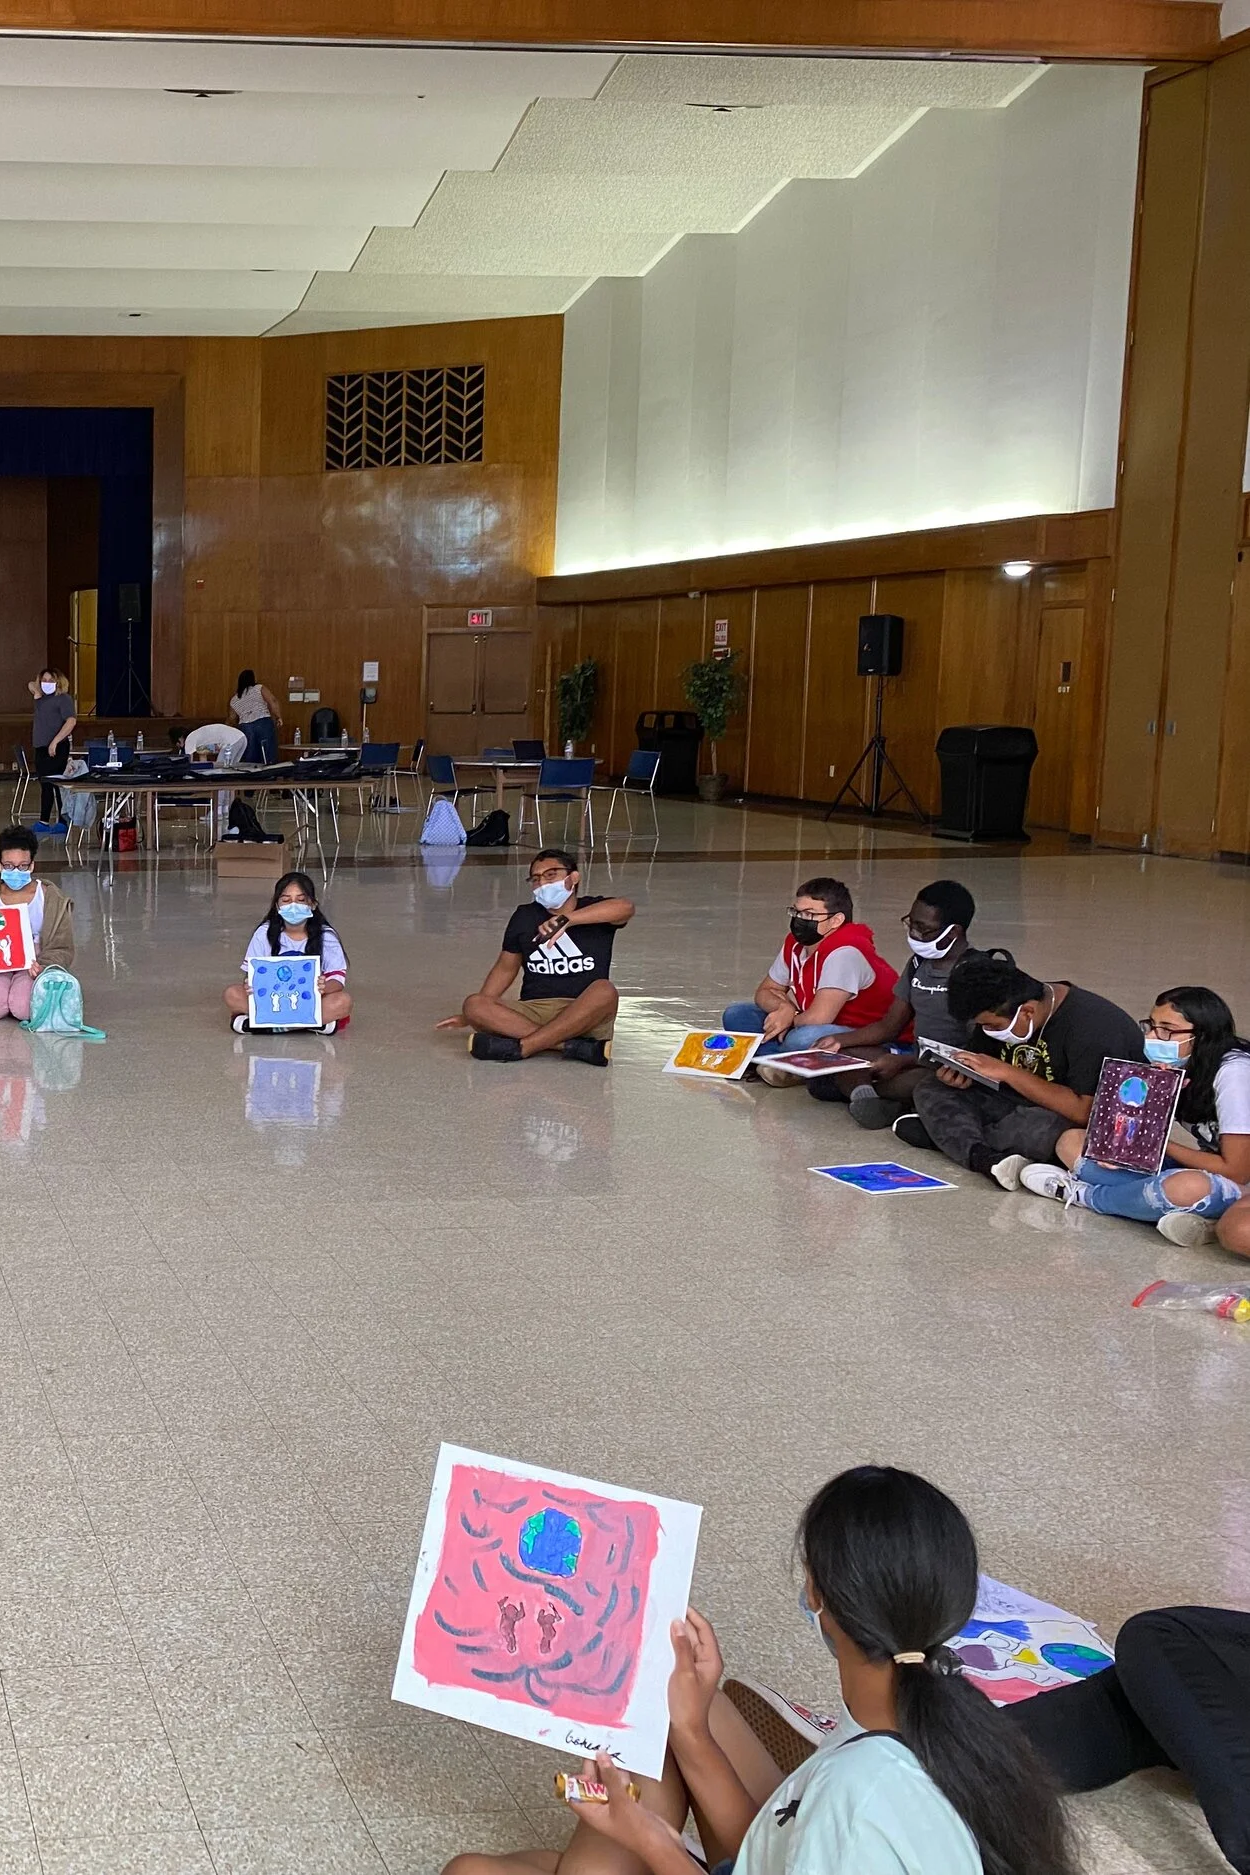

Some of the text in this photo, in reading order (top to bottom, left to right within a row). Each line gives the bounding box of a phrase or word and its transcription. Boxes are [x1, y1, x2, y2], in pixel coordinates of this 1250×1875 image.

[471, 612, 489, 625] EXIT
[527, 956, 595, 975] adidas
[911, 977, 948, 995] Champion
